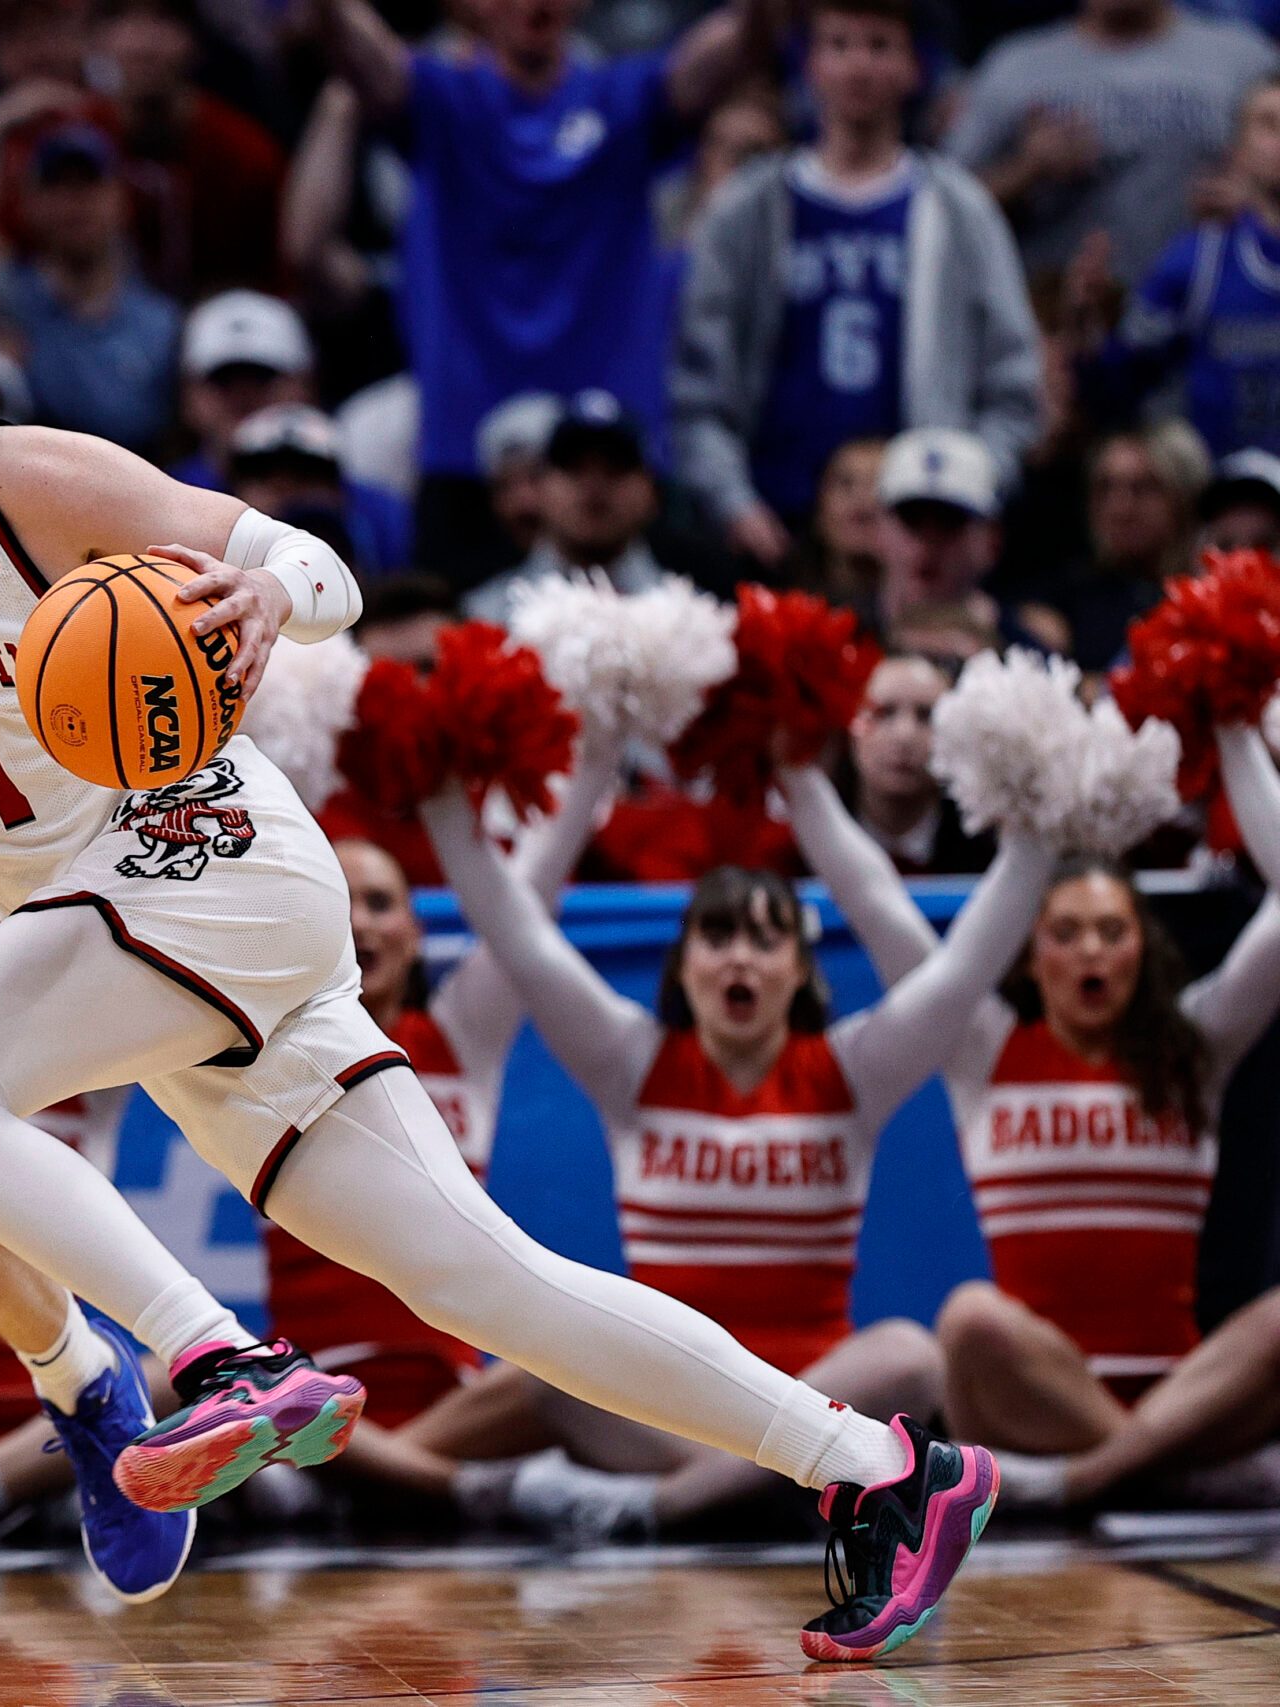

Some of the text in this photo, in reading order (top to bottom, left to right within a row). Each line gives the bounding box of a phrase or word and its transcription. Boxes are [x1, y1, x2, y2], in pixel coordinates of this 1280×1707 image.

[822, 299, 881, 388] 6
[130, 675, 142, 723] OFFICIAL
[137, 724, 146, 753] GAME
[141, 675, 180, 773] NCAA
[642, 1130, 847, 1188] BADGERS
